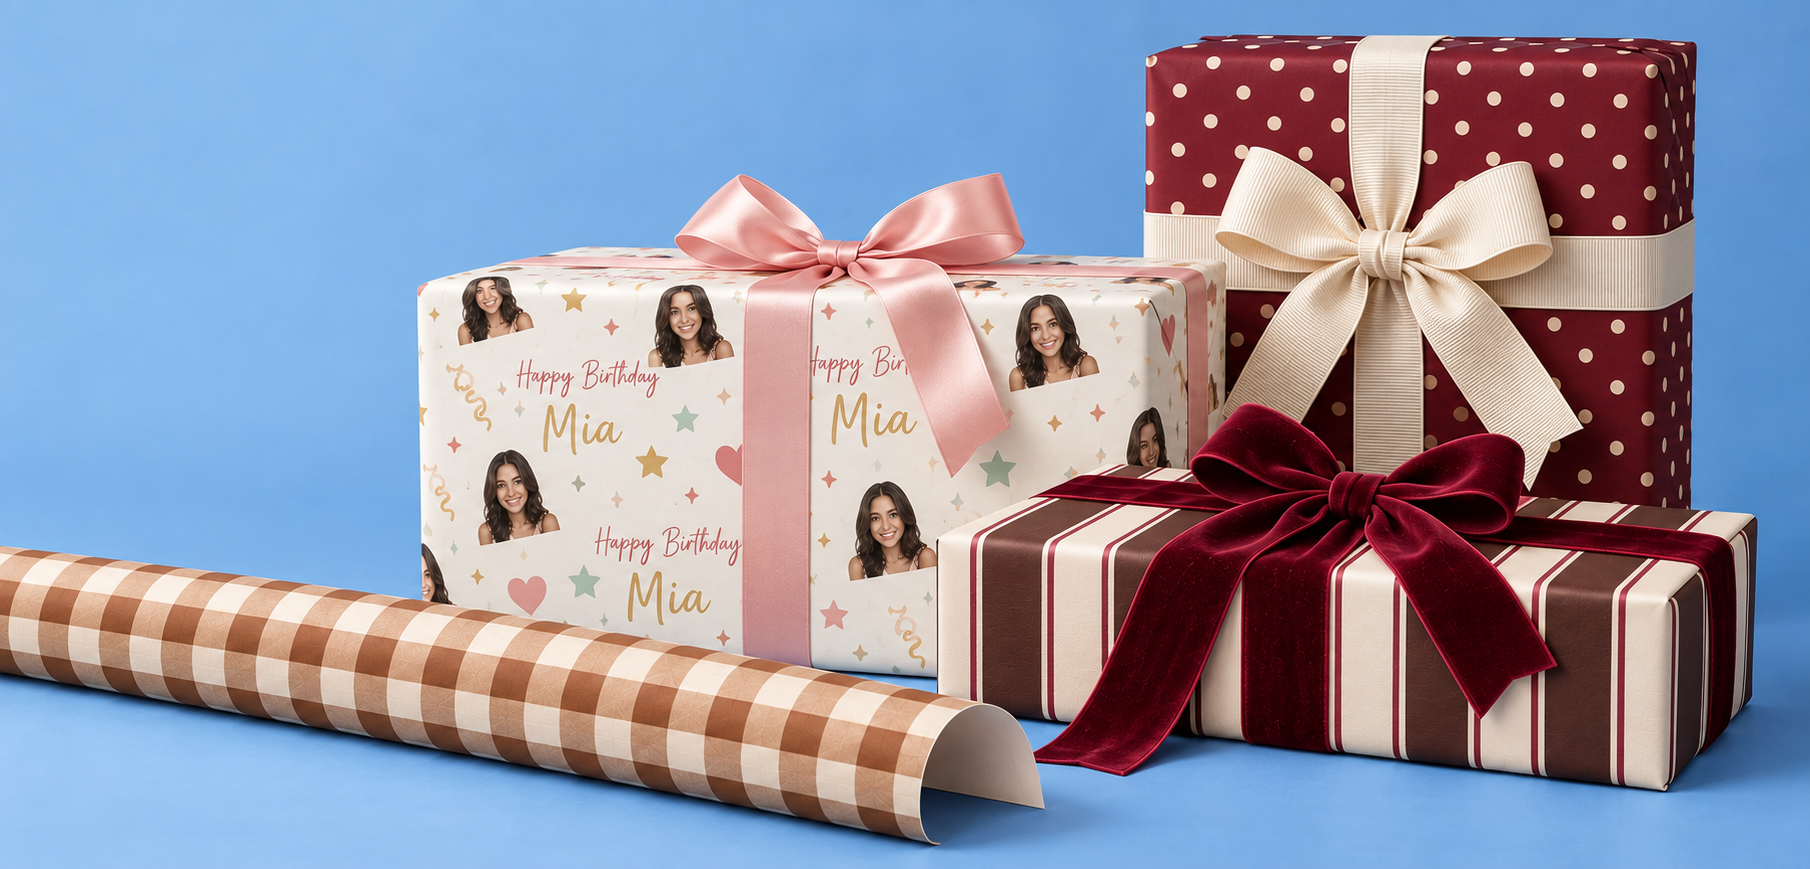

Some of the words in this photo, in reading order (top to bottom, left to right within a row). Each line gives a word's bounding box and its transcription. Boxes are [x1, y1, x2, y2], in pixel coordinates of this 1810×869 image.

[516, 358, 575, 398] Happy
[581, 359, 661, 399] Birthday
[543, 402, 623, 456] Mia
[832, 391, 918, 448] Mia
[594, 525, 655, 566] Happy
[661, 526, 743, 567] Birthday
[627, 570, 712, 626] Mia
